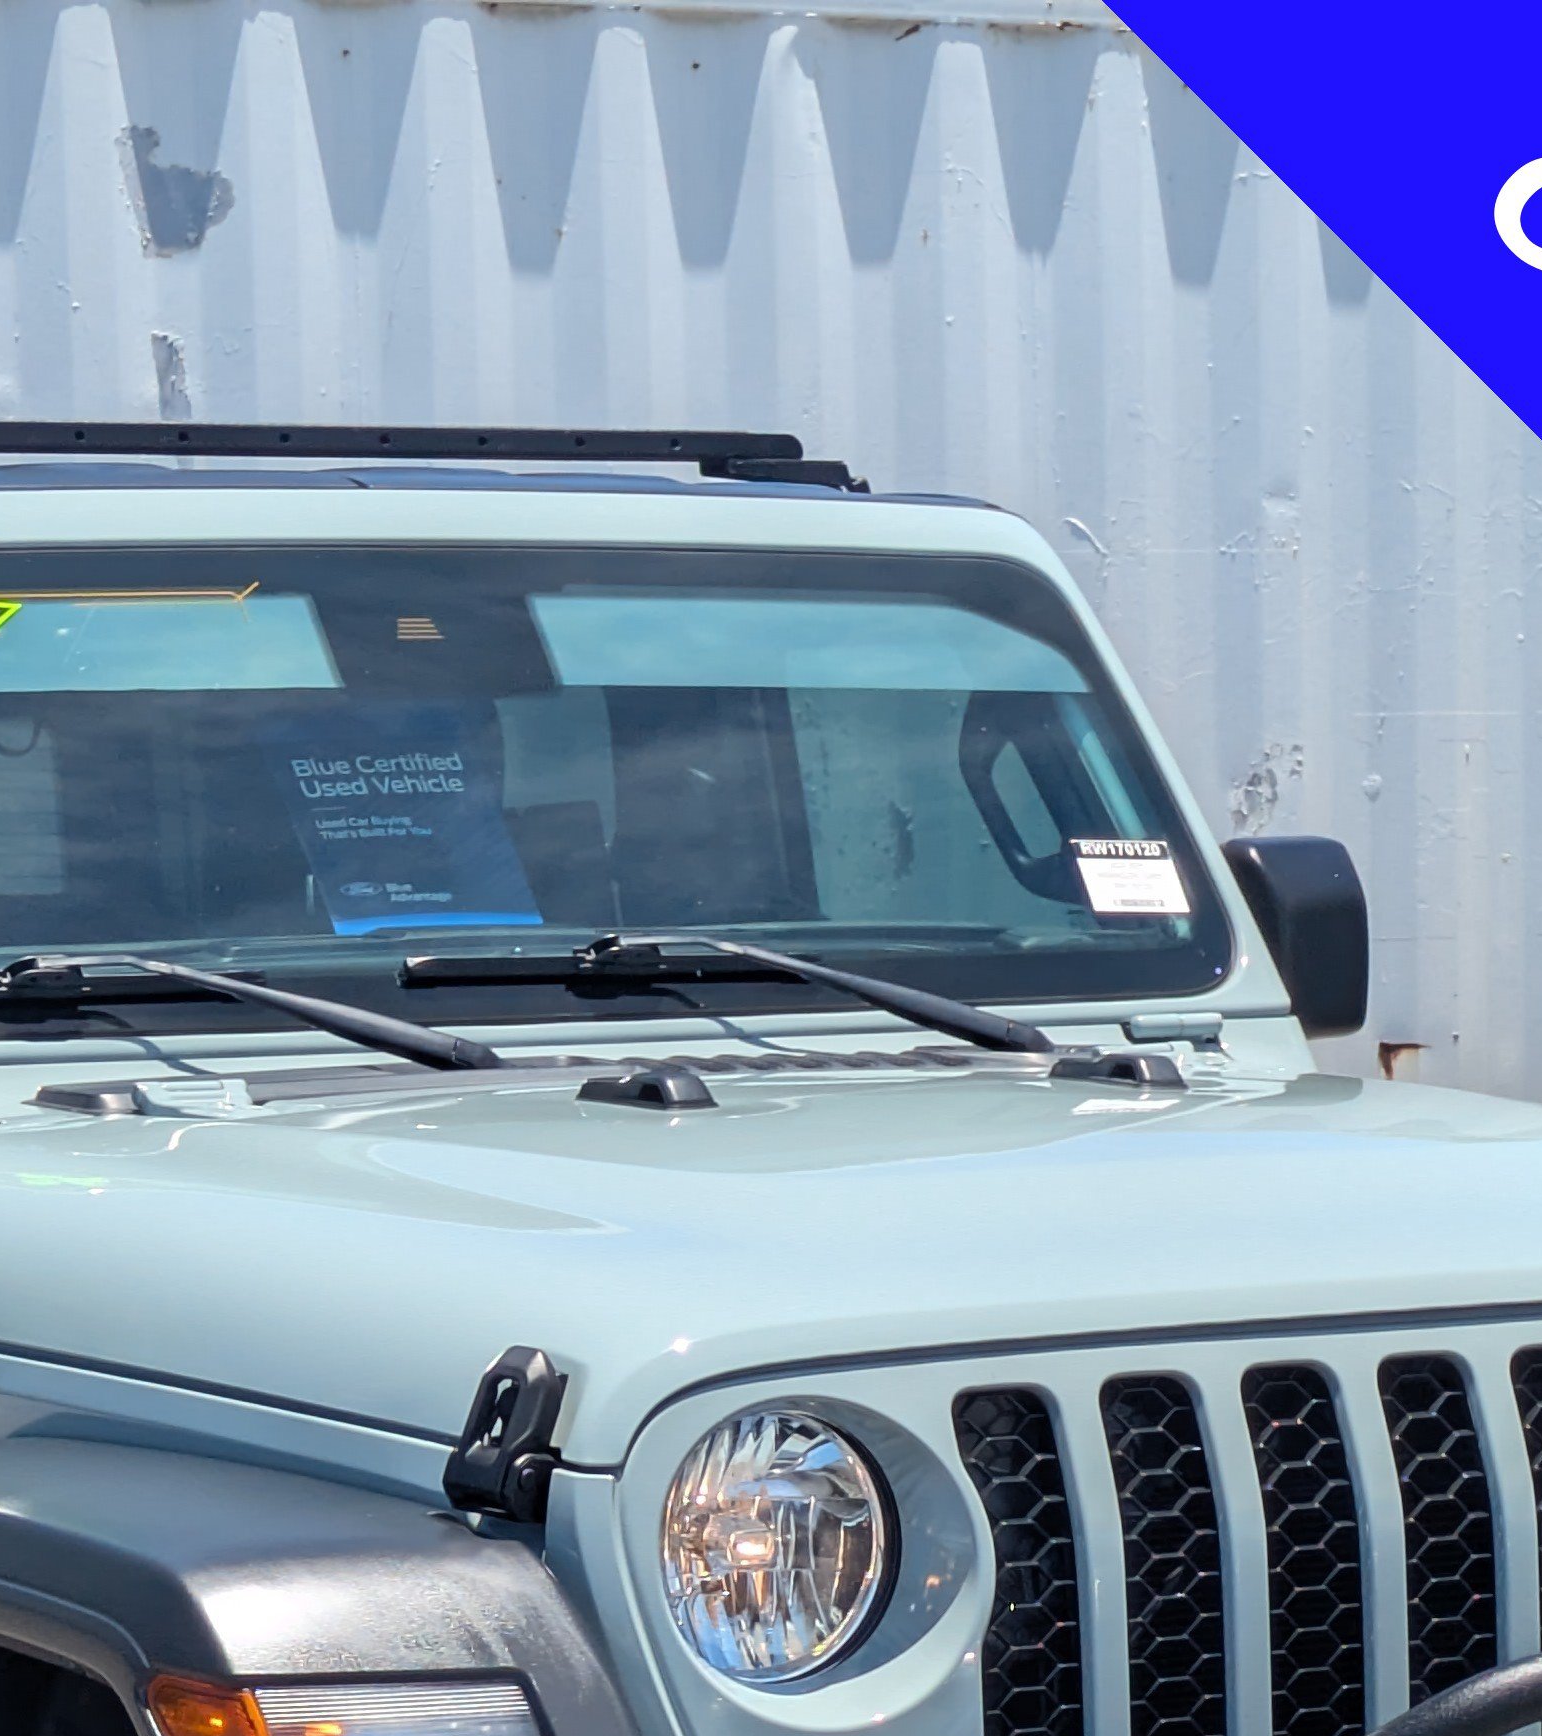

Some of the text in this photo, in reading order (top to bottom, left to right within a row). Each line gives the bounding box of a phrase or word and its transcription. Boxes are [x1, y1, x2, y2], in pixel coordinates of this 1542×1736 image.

[291, 752, 464, 777] Blue Certified
[299, 773, 465, 798] Used Vehicle
